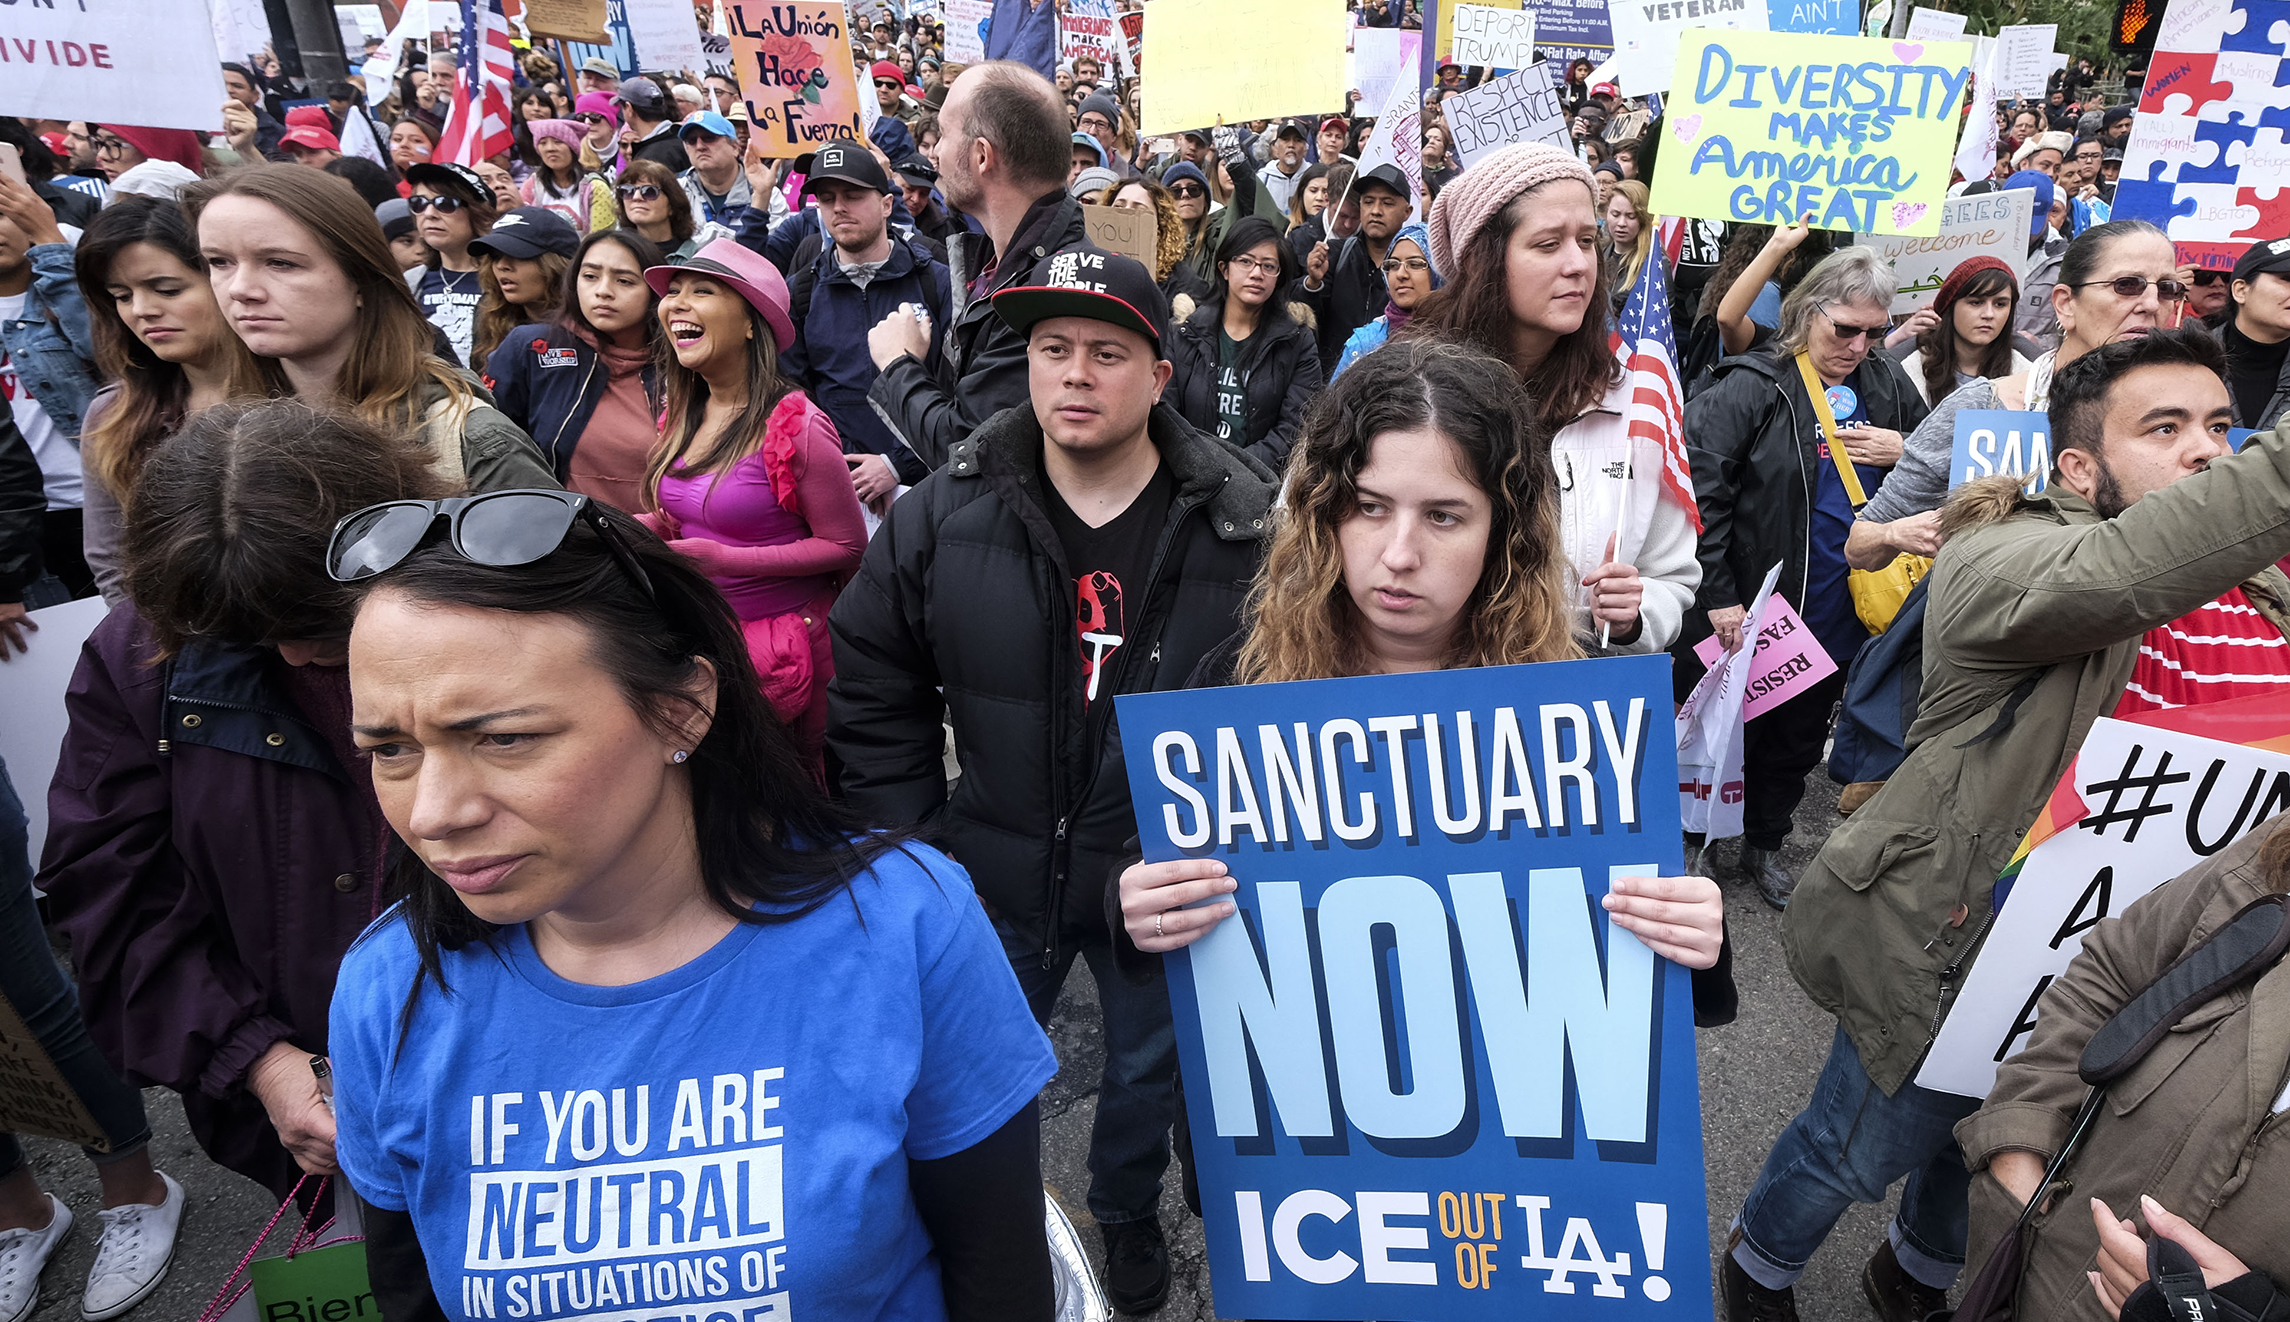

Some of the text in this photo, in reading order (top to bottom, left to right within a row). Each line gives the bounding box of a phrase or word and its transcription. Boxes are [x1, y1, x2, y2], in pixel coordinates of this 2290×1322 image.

[771, 5, 839, 39] Unión
[1062, 14, 1112, 36] IMMIGRANTS
[1458, 6, 1532, 39] DEPORT
[1552, 8, 1573, 16] Parking
[1643, 0, 1745, 22] VETERAN
[2163, 3, 2220, 47] Americans
[0, 37, 113, 69] IVIDE
[1064, 43, 1113, 64] AMERICA
[1071, 34, 1101, 46] make
[1454, 37, 1530, 67] TRUMP
[1547, 47, 1564, 59] Flat
[1588, 49, 1610, 61] After
[755, 51, 830, 89] Hace
[1695, 43, 1969, 121] DIVERSITY
[2145, 61, 2192, 98] WOMEN
[2221, 62, 2273, 83] Muslims
[1450, 60, 1549, 126] RESPECT
[783, 98, 860, 144] Fuerza!
[1454, 87, 1563, 154] EXISTENCE
[1608, 114, 1631, 140] NO
[1768, 111, 1895, 151] MAKES
[2133, 129, 2198, 155] Immigrants
[1690, 135, 1918, 192] America
[2244, 149, 2290, 176] Refuge
[1730, 180, 1894, 233] GREAT
[1940, 197, 2011, 227] GEES
[2199, 207, 2254, 220] LBGTQ+
[1092, 222, 1132, 242] YOU
[1048, 266, 1079, 288] THE
[1051, 252, 1105, 270] SERVE
[1744, 652, 1813, 703] RESIST
[1152, 697, 1646, 849] SANCTUARY
[1189, 864, 1659, 1143] NOW
[471, 1067, 785, 1166] IF YOU ARE
[478, 1159, 771, 1260] NEUTRAL
[1437, 1190, 1505, 1240] OUT
[1235, 1189, 1438, 1285] ICE
[463, 1245, 787, 1319] IN SITUATIONS OF
[1455, 1242, 1498, 1290] OF
